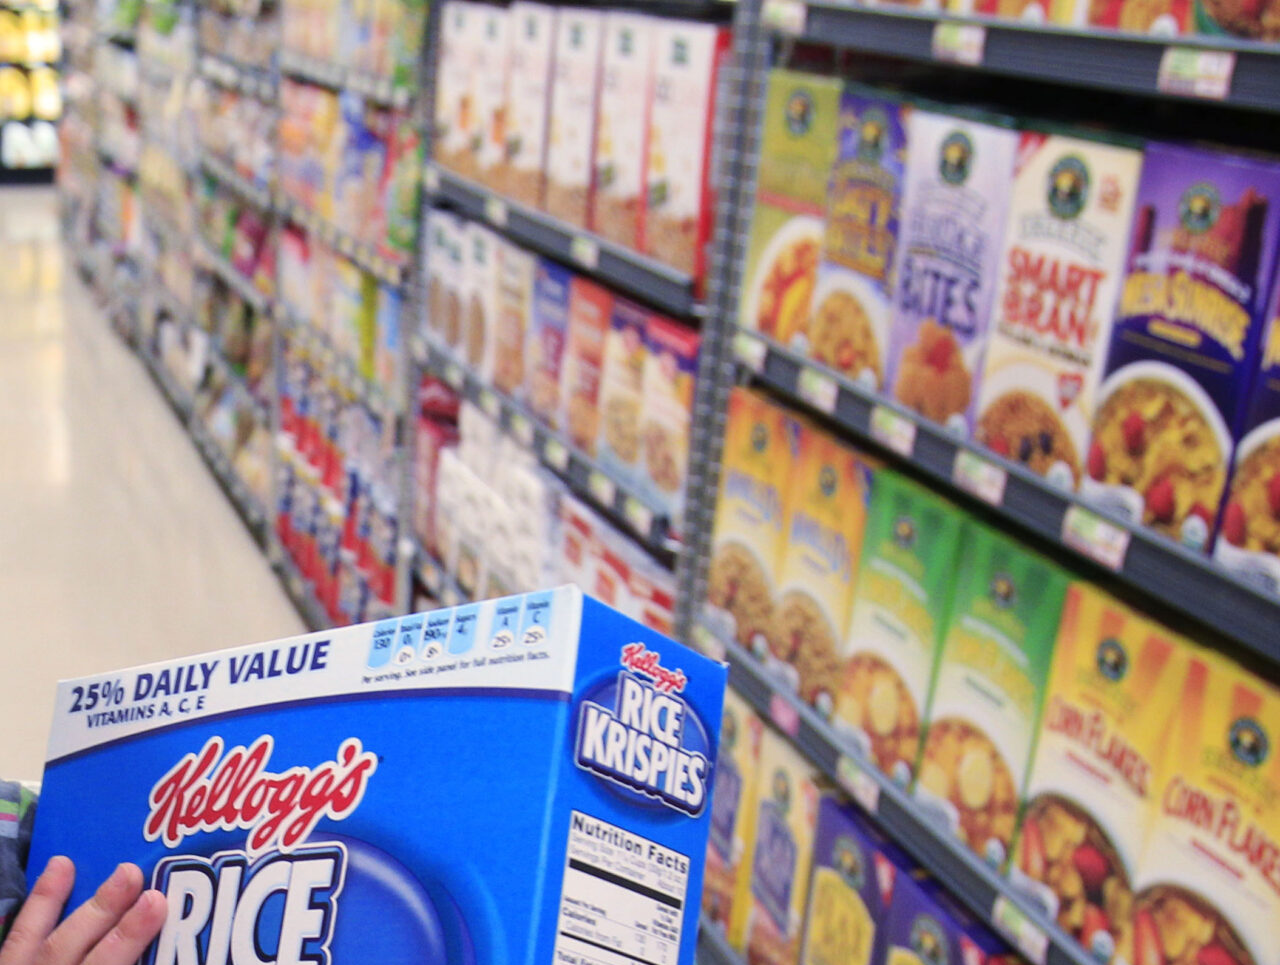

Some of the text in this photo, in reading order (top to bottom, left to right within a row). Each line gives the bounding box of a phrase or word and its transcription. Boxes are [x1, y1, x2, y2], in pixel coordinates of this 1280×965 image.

[69, 640, 331, 713] 25% DAILY VALUE
[623, 642, 687, 692] Kellogg's
[86, 696, 206, 729] VITAMINS A, C, E
[621, 677, 683, 746] RICE
[582, 707, 704, 806] KRISPIES
[147, 739, 373, 851] Kellogg's
[572, 814, 687, 874] Nutrition Facts
